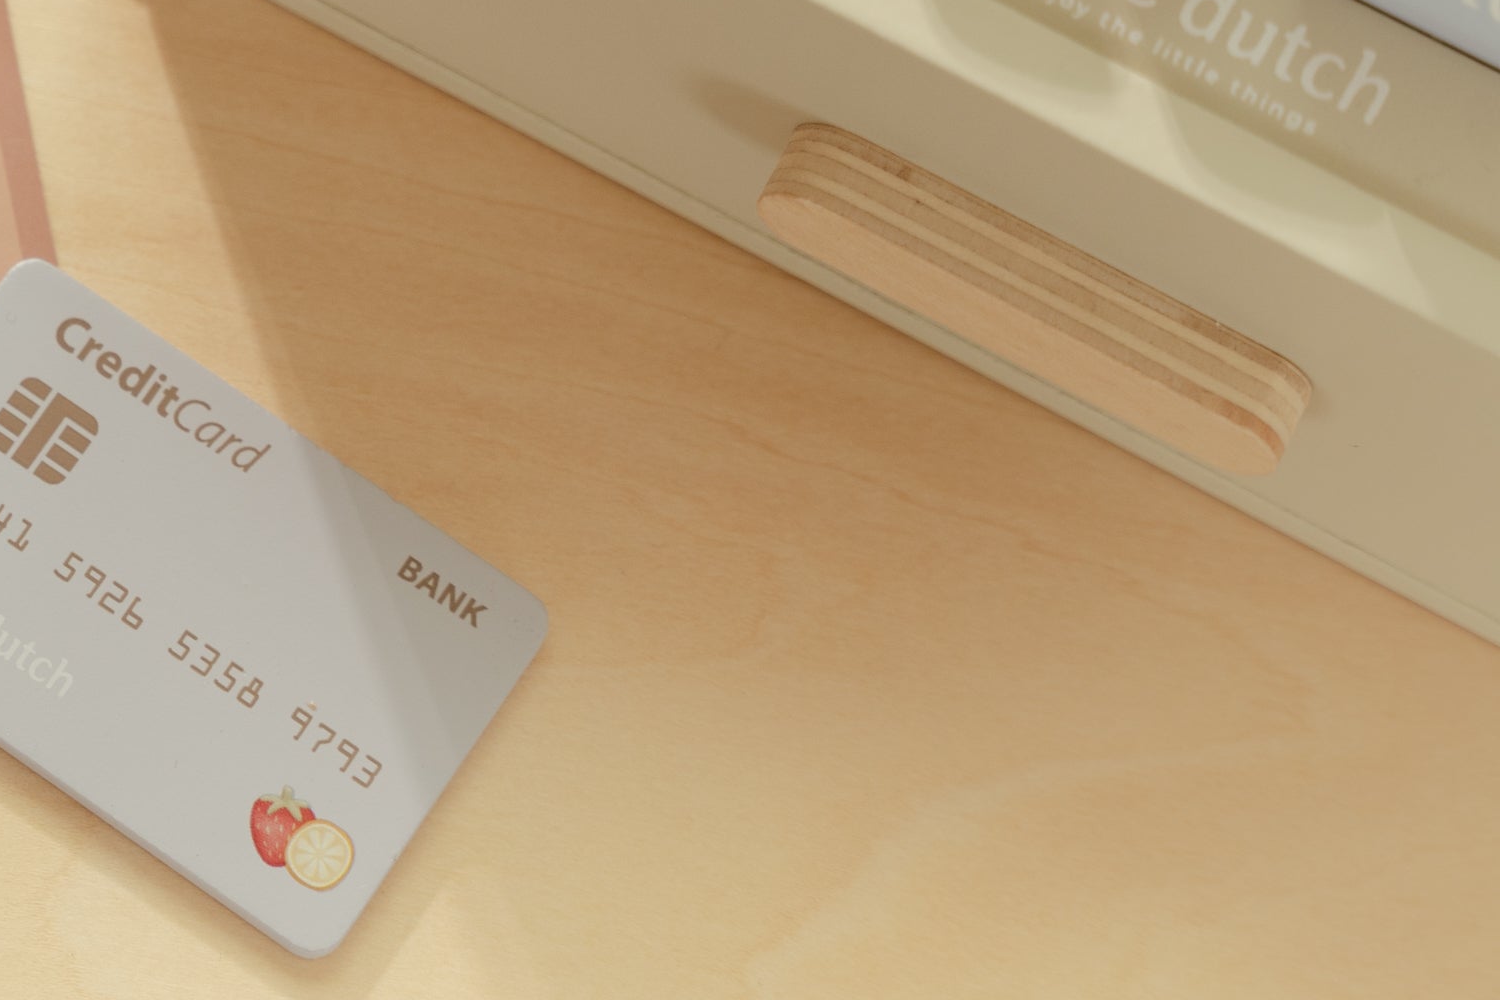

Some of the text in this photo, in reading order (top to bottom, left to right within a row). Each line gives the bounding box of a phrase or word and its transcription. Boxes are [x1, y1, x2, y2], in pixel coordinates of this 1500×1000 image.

[1098, 9, 1145, 47] the
[1152, 34, 1221, 86] little
[1229, 75, 1320, 137] things
[55, 316, 272, 474] CreditCard
[397, 555, 489, 629] BANK
[52, 551, 145, 632] 5926
[167, 629, 265, 709] 5358
[290, 704, 384, 790] 9793
